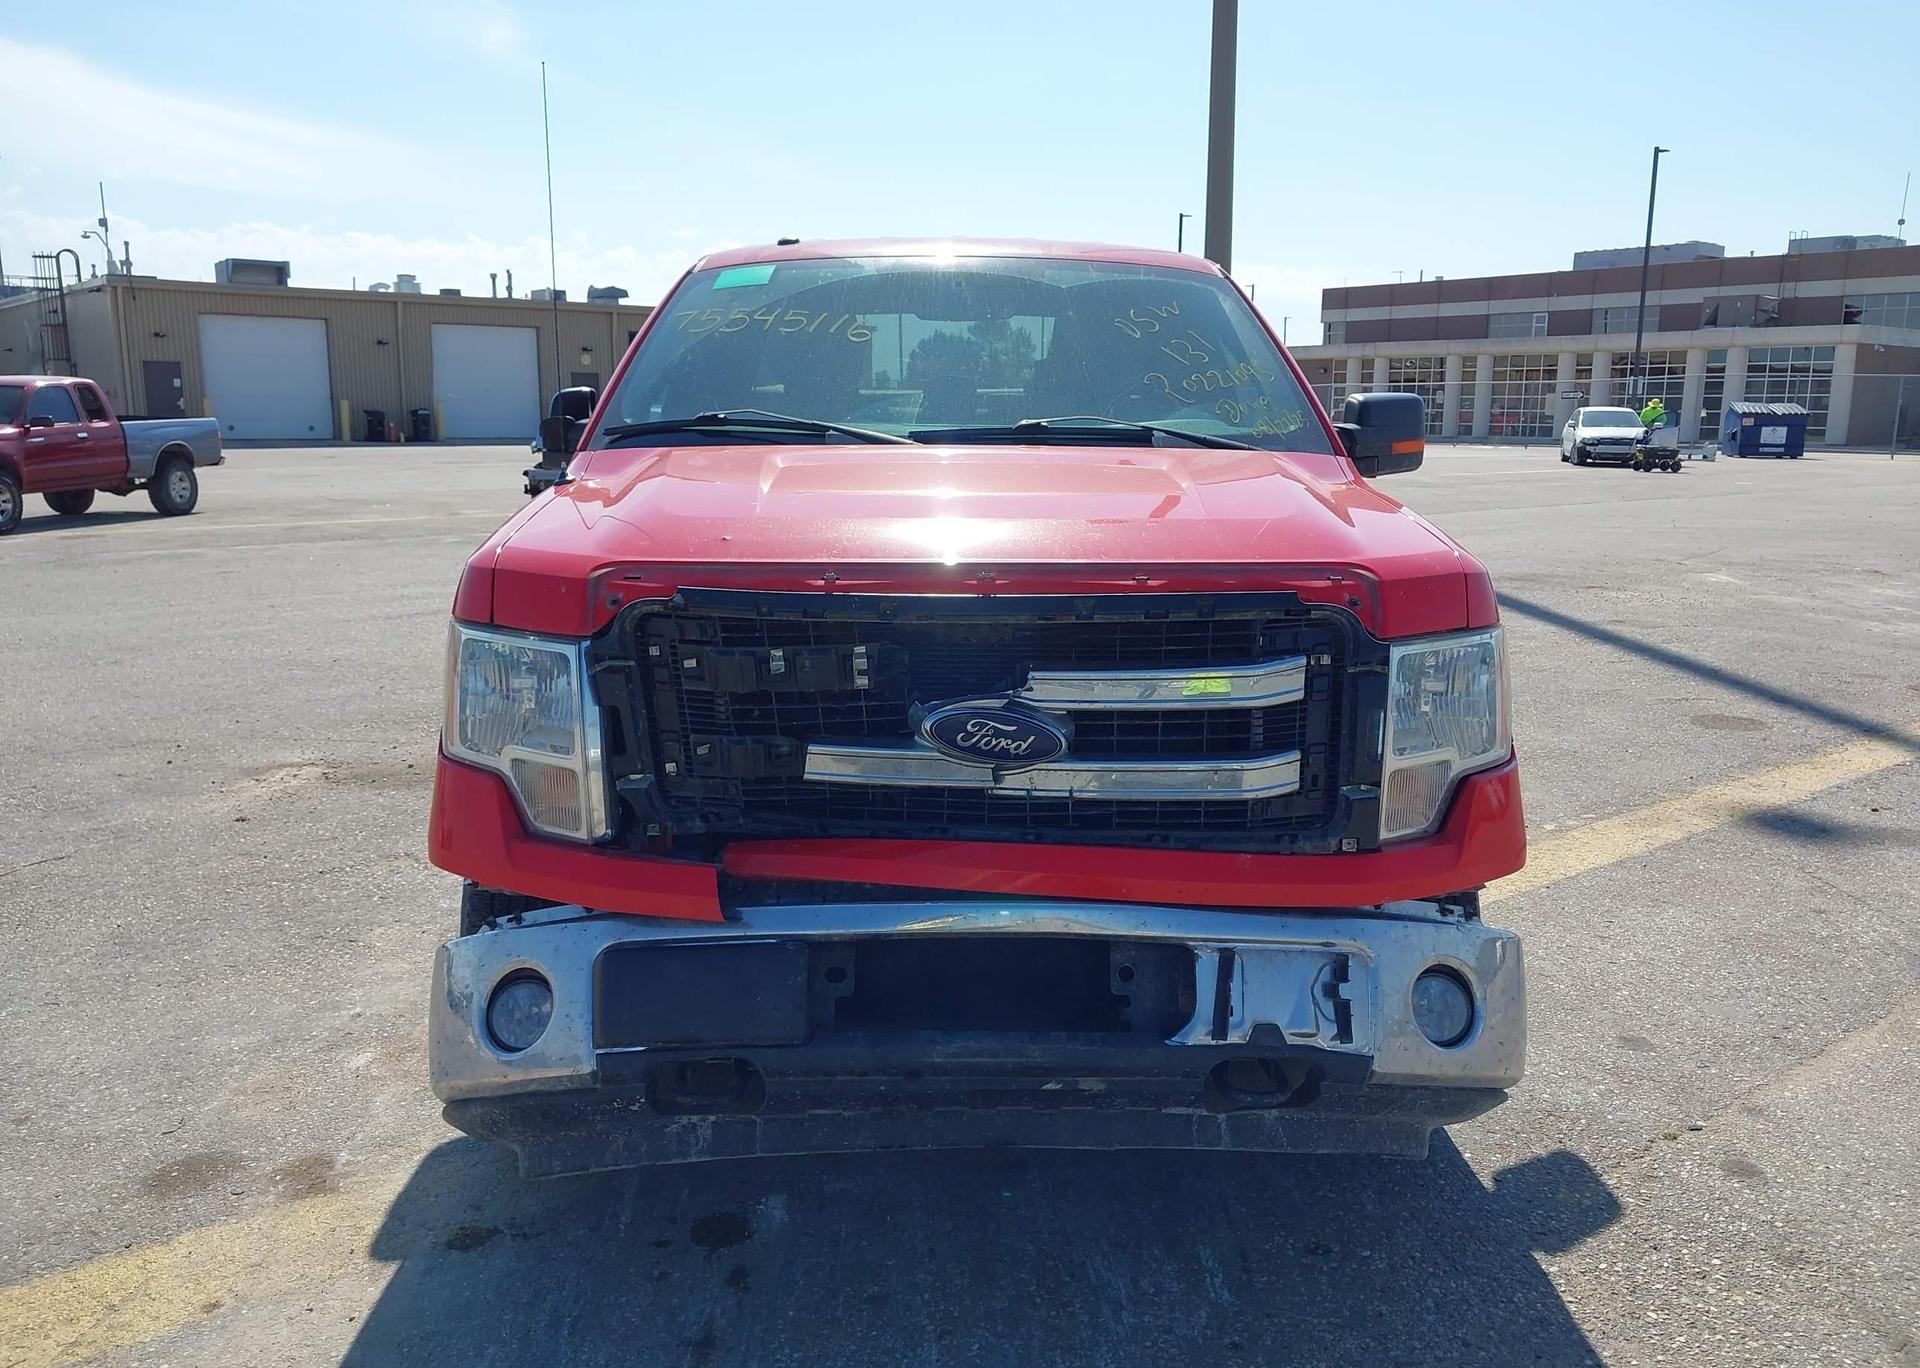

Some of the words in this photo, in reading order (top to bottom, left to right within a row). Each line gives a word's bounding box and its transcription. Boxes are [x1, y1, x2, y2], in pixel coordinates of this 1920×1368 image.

[677, 307, 872, 342] 75545116
[1160, 330, 1216, 366] 131
[956, 719, 1036, 756] Ford
